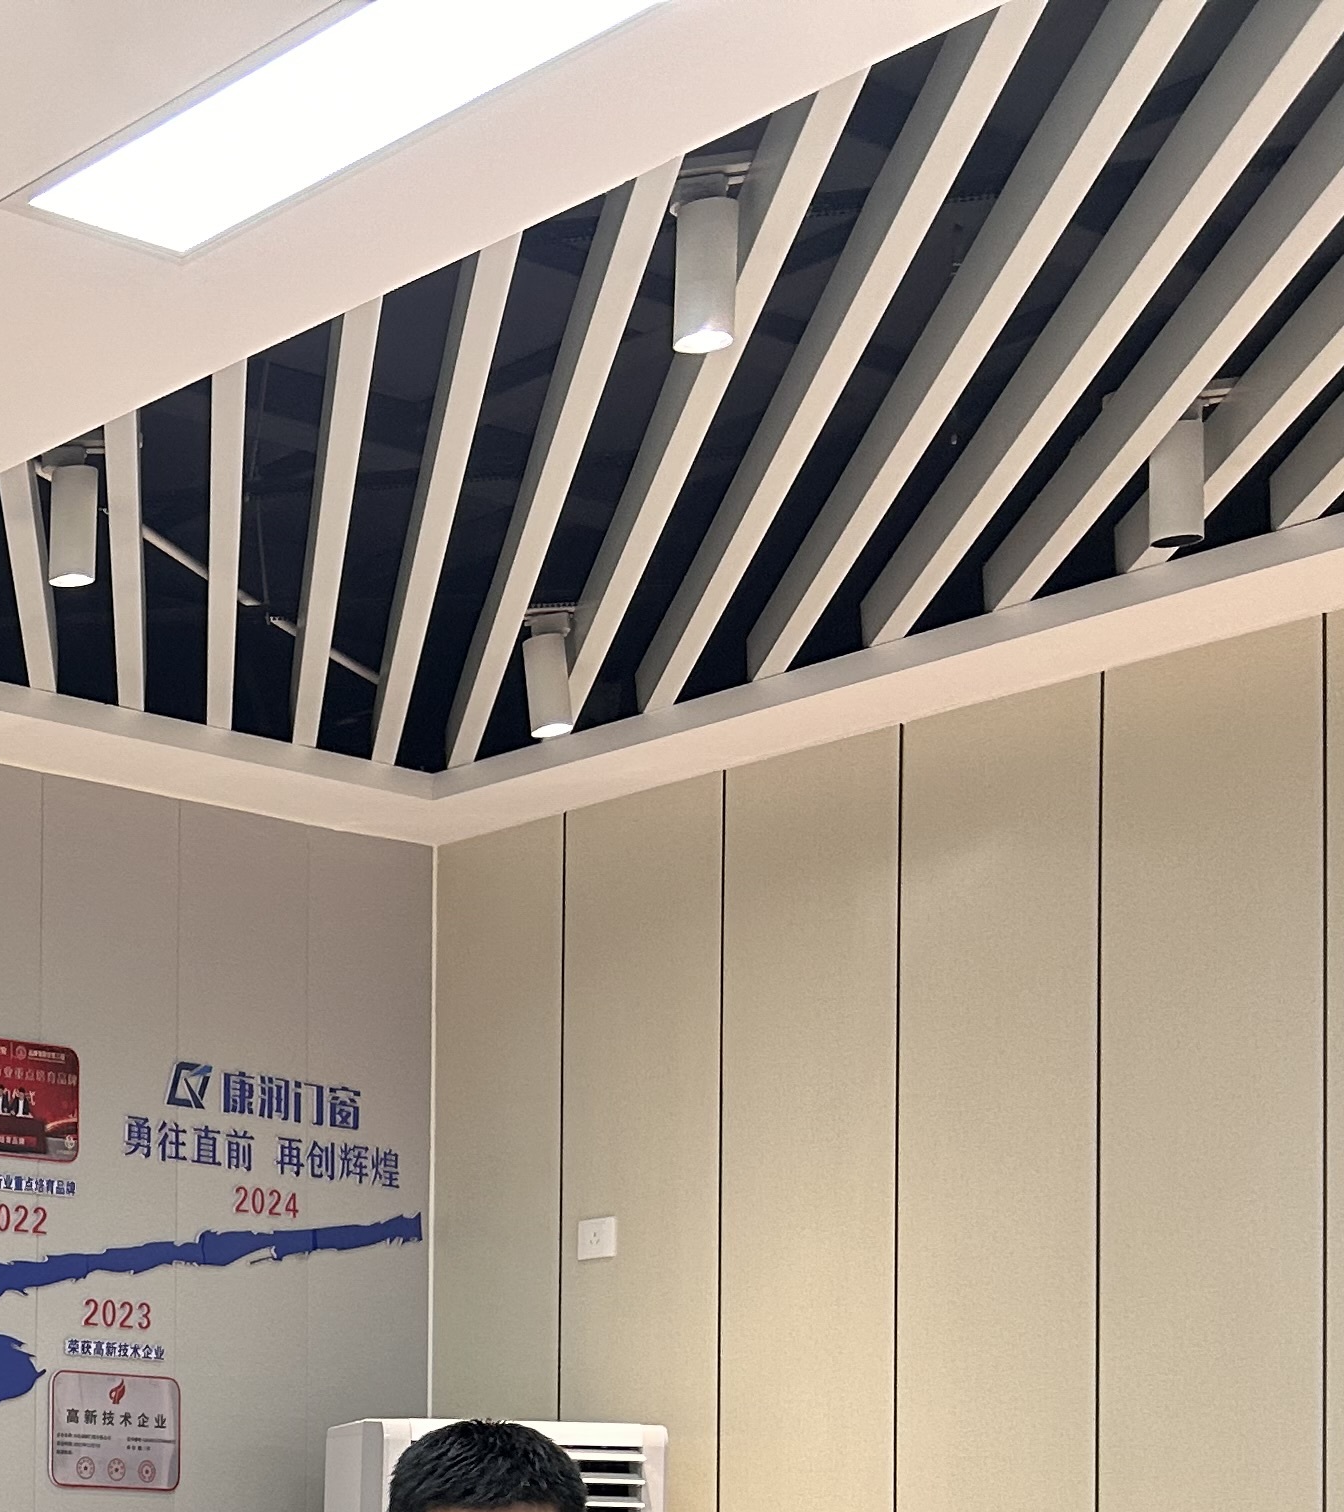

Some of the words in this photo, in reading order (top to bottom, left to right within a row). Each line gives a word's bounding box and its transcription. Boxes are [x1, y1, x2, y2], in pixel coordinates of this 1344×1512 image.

[222, 1072, 360, 1130] 康润门窗
[124, 1116, 254, 1171] 勇往直前
[275, 1136, 400, 1188] 再创辉煌
[235, 1186, 299, 1217] 2024
[83, 1298, 151, 1330] 2023
[68, 1339, 165, 1361] 荣获高新技术企业
[66, 1408, 167, 1429] 高新技术企业
